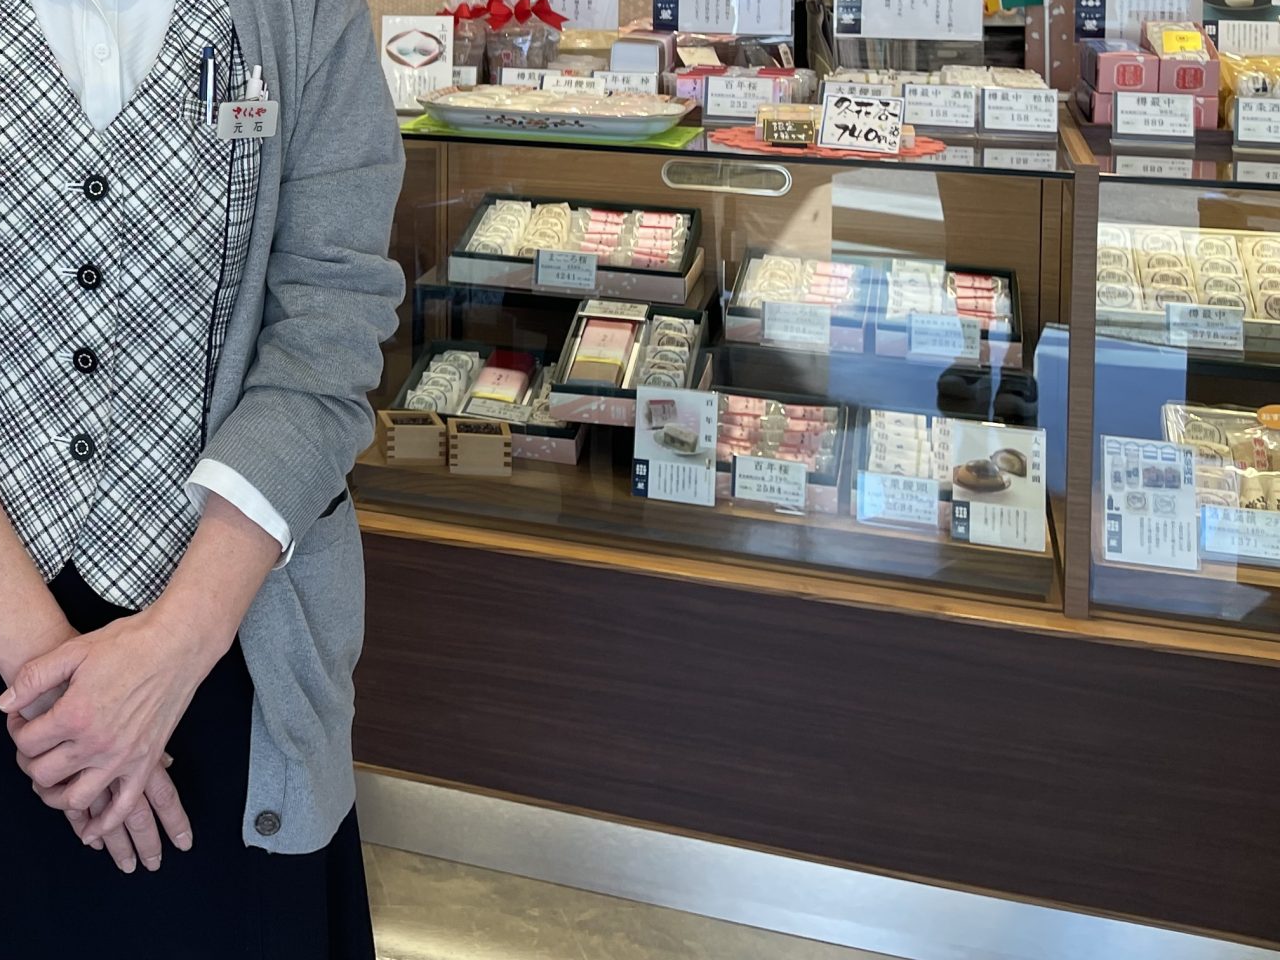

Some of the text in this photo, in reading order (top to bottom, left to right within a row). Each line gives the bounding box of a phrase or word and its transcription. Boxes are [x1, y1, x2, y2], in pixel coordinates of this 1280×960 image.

[725, 80, 757, 91] 百年桜
[1137, 96, 1175, 107] 樽最中
[233, 107, 266, 119] さくらや
[234, 121, 263, 133] 元石
[754, 461, 789, 475] 百年桜
